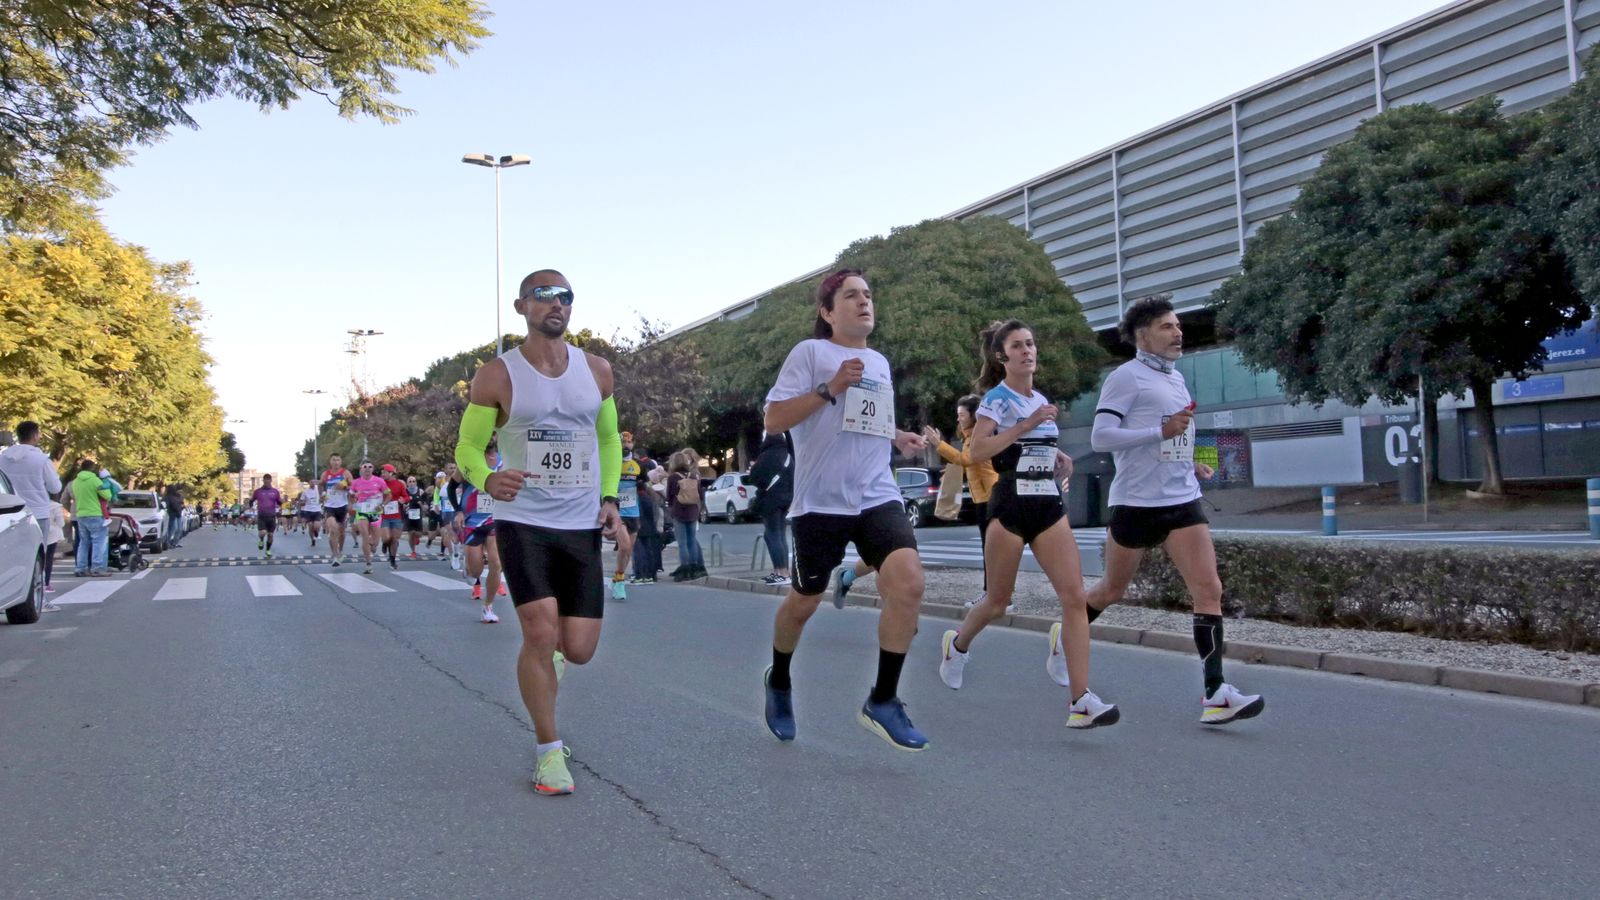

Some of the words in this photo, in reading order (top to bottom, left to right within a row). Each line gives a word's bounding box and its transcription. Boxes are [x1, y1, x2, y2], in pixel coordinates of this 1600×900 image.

[1512, 382, 1521, 397] 3
[861, 399, 876, 417] 20
[1385, 414, 1411, 424] Tribuna
[529, 431, 543, 440] XXV
[541, 452, 572, 470] 498
